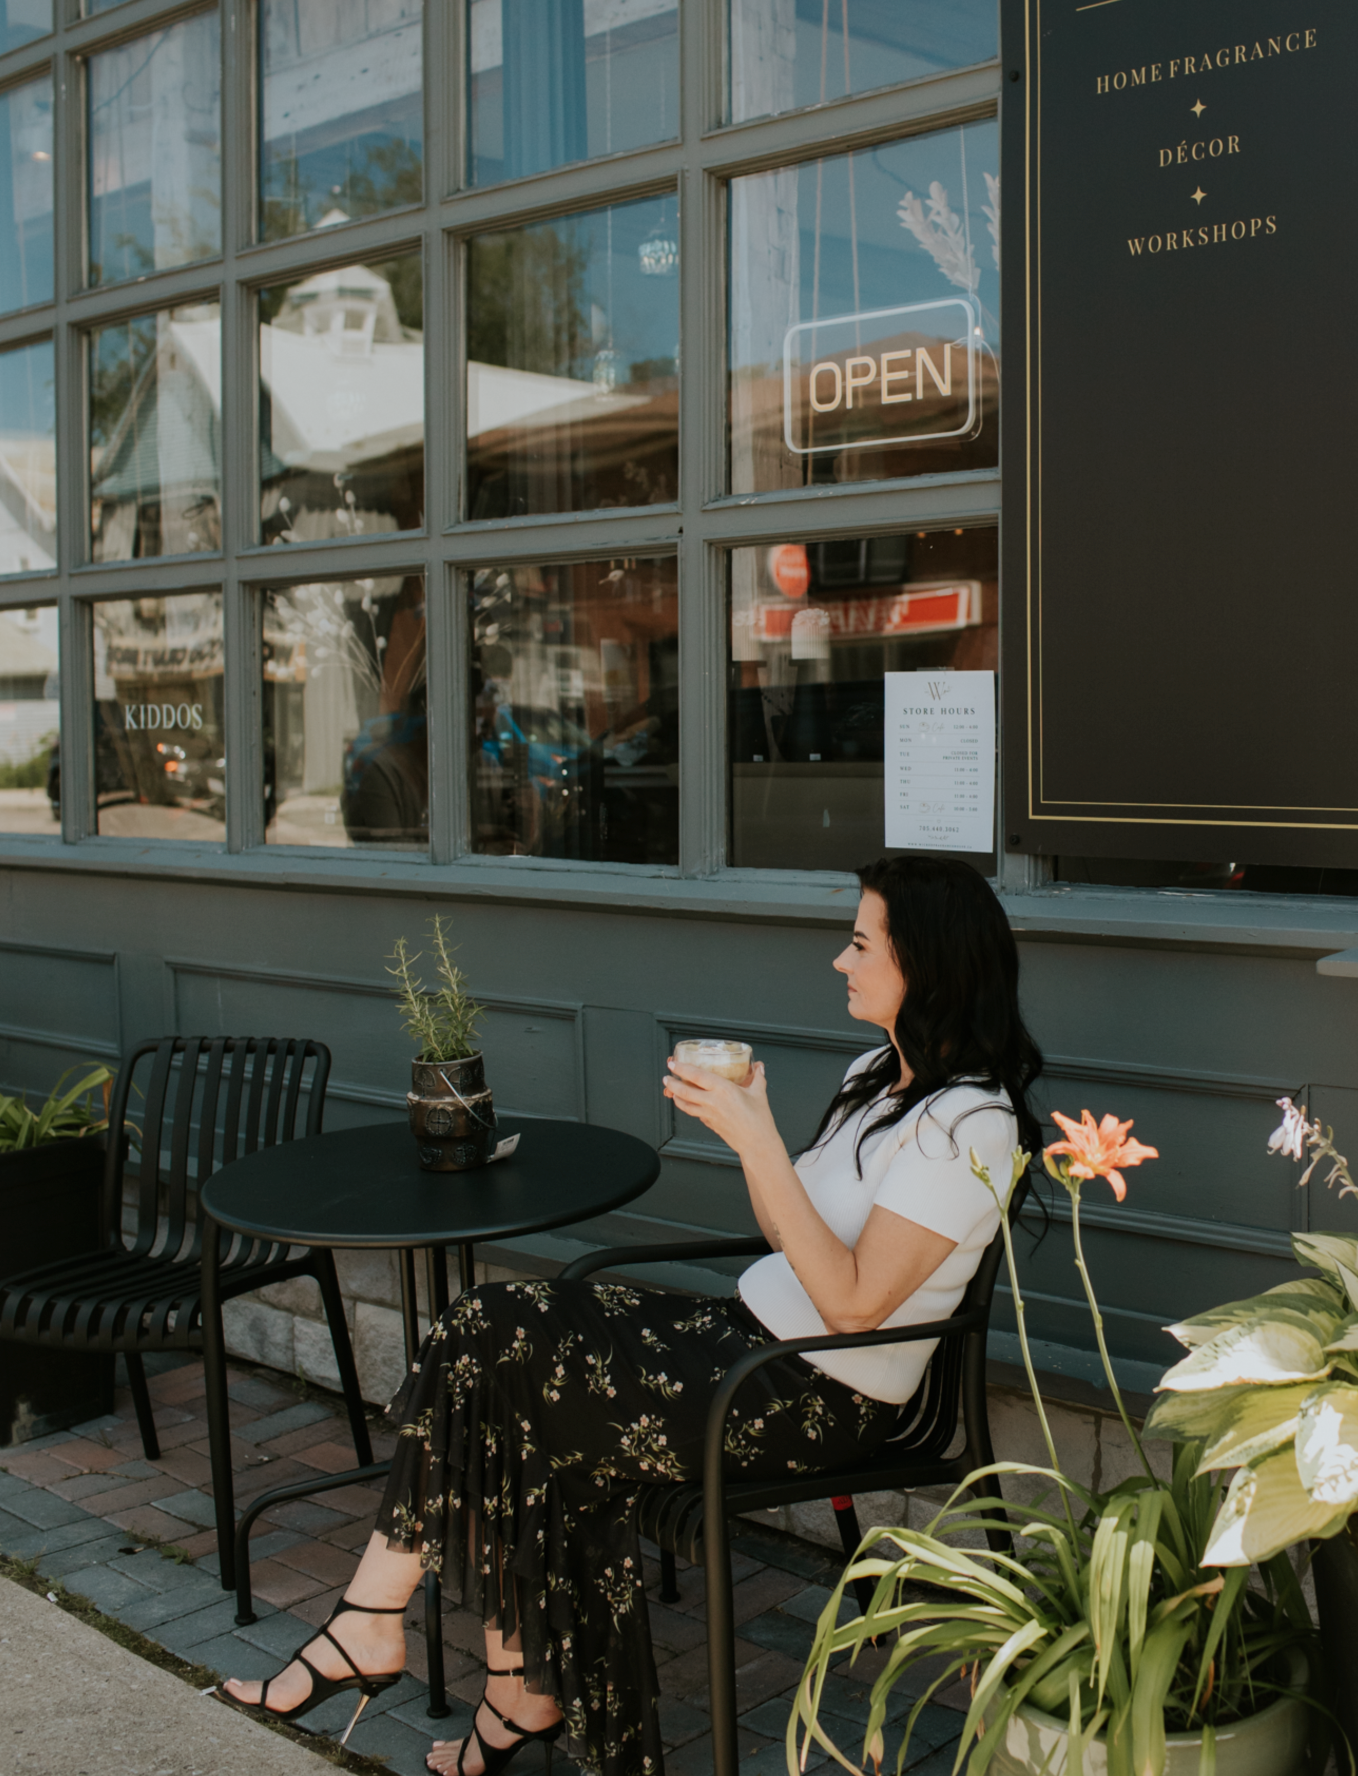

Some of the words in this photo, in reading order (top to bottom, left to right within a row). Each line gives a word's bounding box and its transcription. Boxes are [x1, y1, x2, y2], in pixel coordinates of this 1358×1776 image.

[1096, 63, 1163, 95] HOME
[1168, 28, 1318, 79] FRAGRANCE
[1158, 134, 1242, 168] DÉCOR
[1127, 215, 1278, 257] WORKSHOPS
[809, 342, 952, 413] OPEN
[124, 703, 203, 730] KIDDOS
[902, 707, 935, 715] STORE
[940, 707, 976, 716] HOURS
